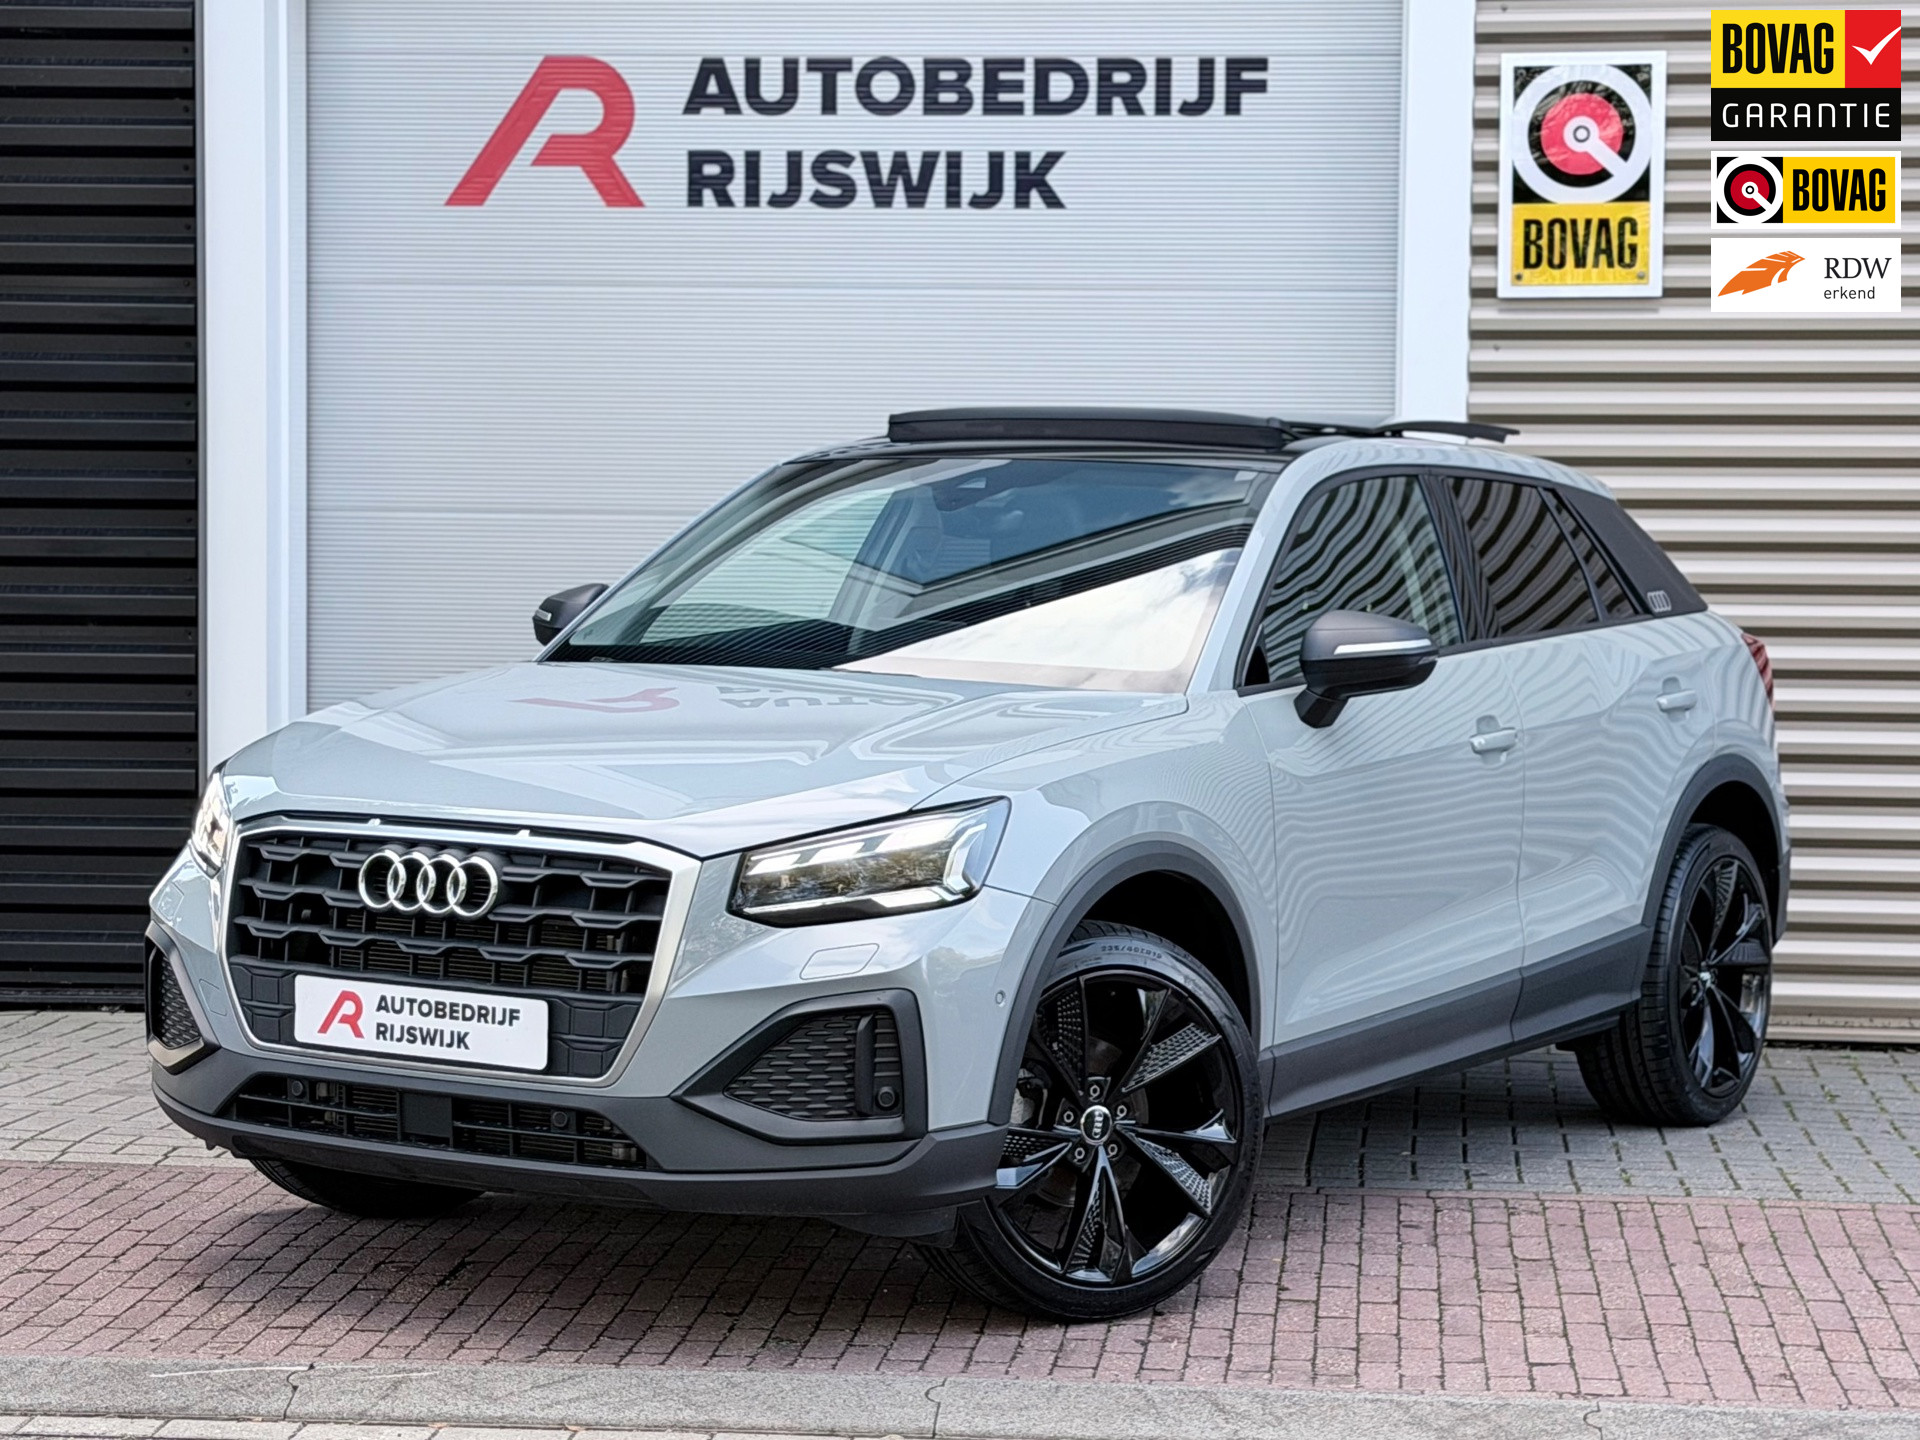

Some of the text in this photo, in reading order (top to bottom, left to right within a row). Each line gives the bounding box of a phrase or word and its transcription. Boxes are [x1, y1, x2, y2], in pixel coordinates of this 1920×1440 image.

[682, 57, 1269, 117] AUTOBEDRIJF
[687, 150, 1067, 209] RIJSWIJK
[1523, 218, 1638, 270] BOVAG
[375, 995, 521, 1027] AUTOBEDRIJF
[375, 1023, 470, 1050] RIJSWIJK
